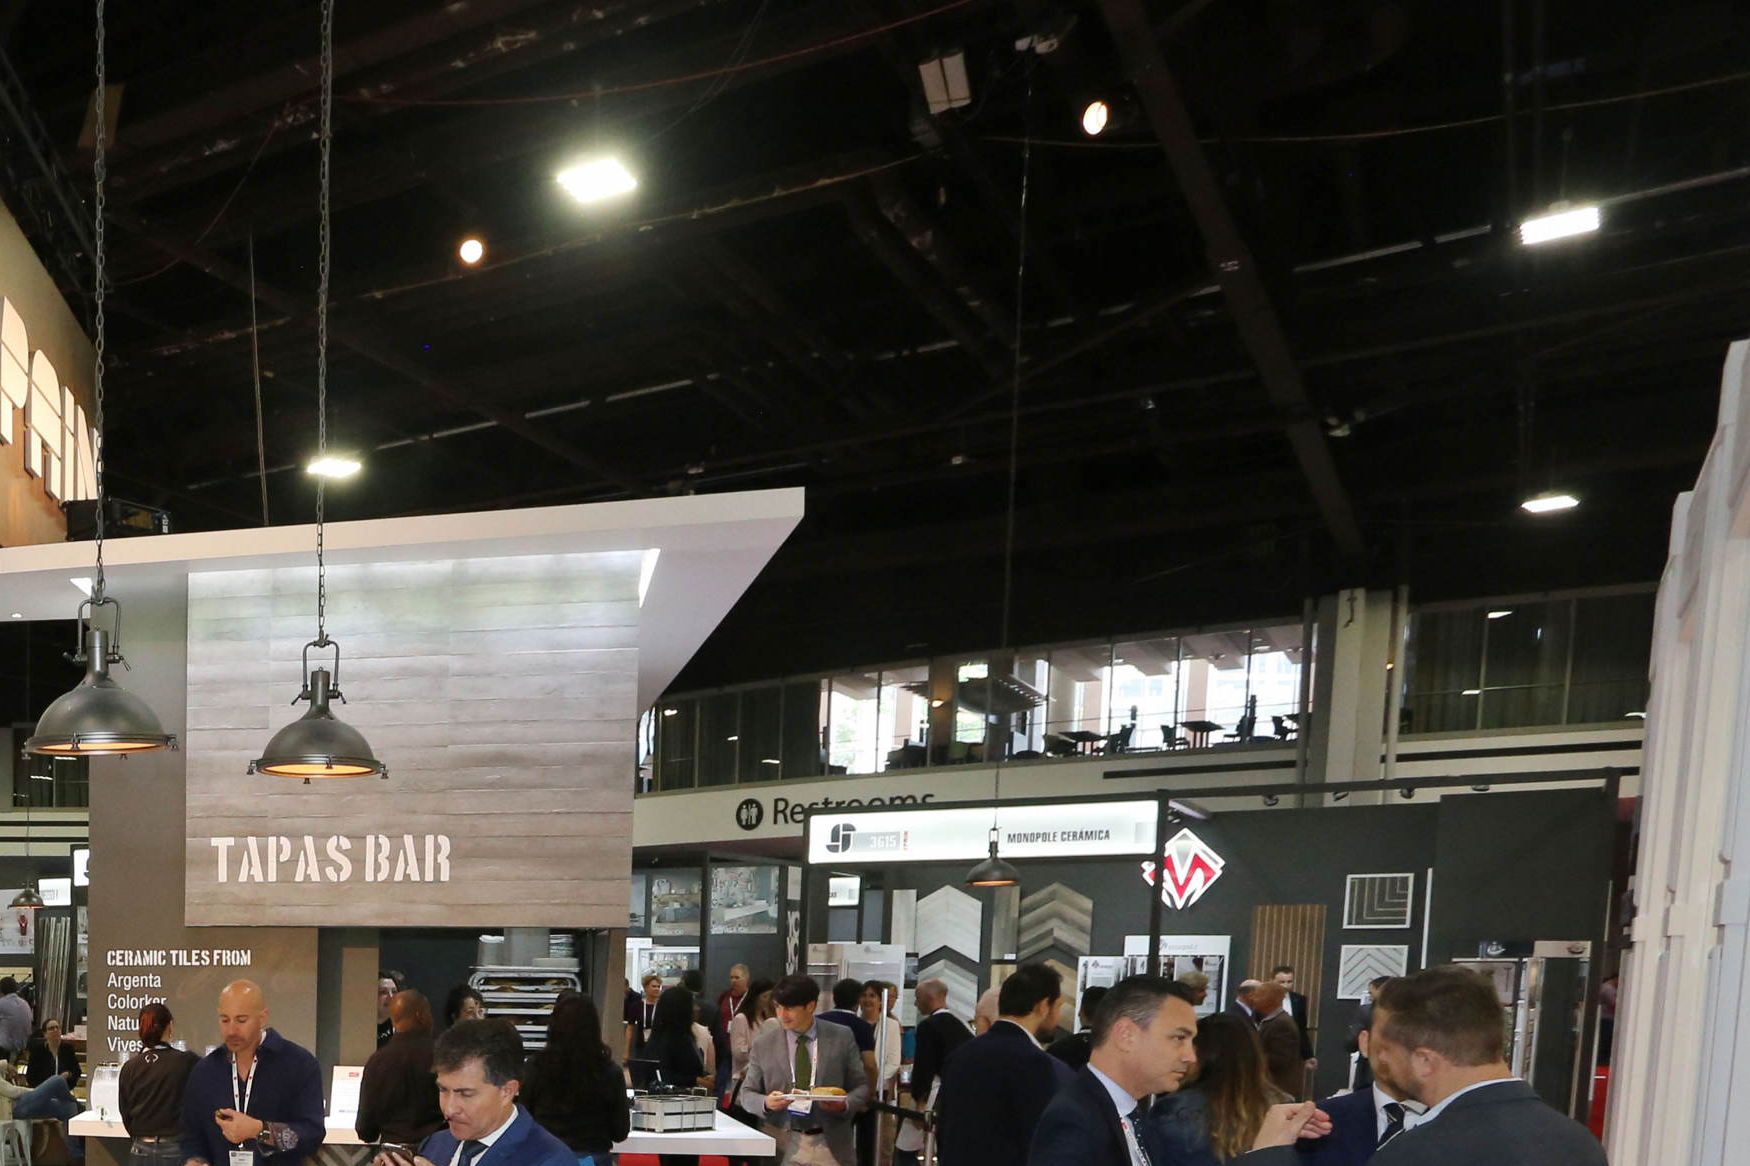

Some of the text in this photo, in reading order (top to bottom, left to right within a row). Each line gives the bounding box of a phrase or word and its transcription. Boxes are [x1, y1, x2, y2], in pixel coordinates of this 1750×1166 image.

[1007, 831, 1057, 844] MONOPOLE
[210, 833, 451, 883] TAPAS BAR
[107, 949, 251, 966] CERAMIC TILES FROM
[107, 972, 162, 990] Argenta
[107, 1037, 144, 1052] Vives
